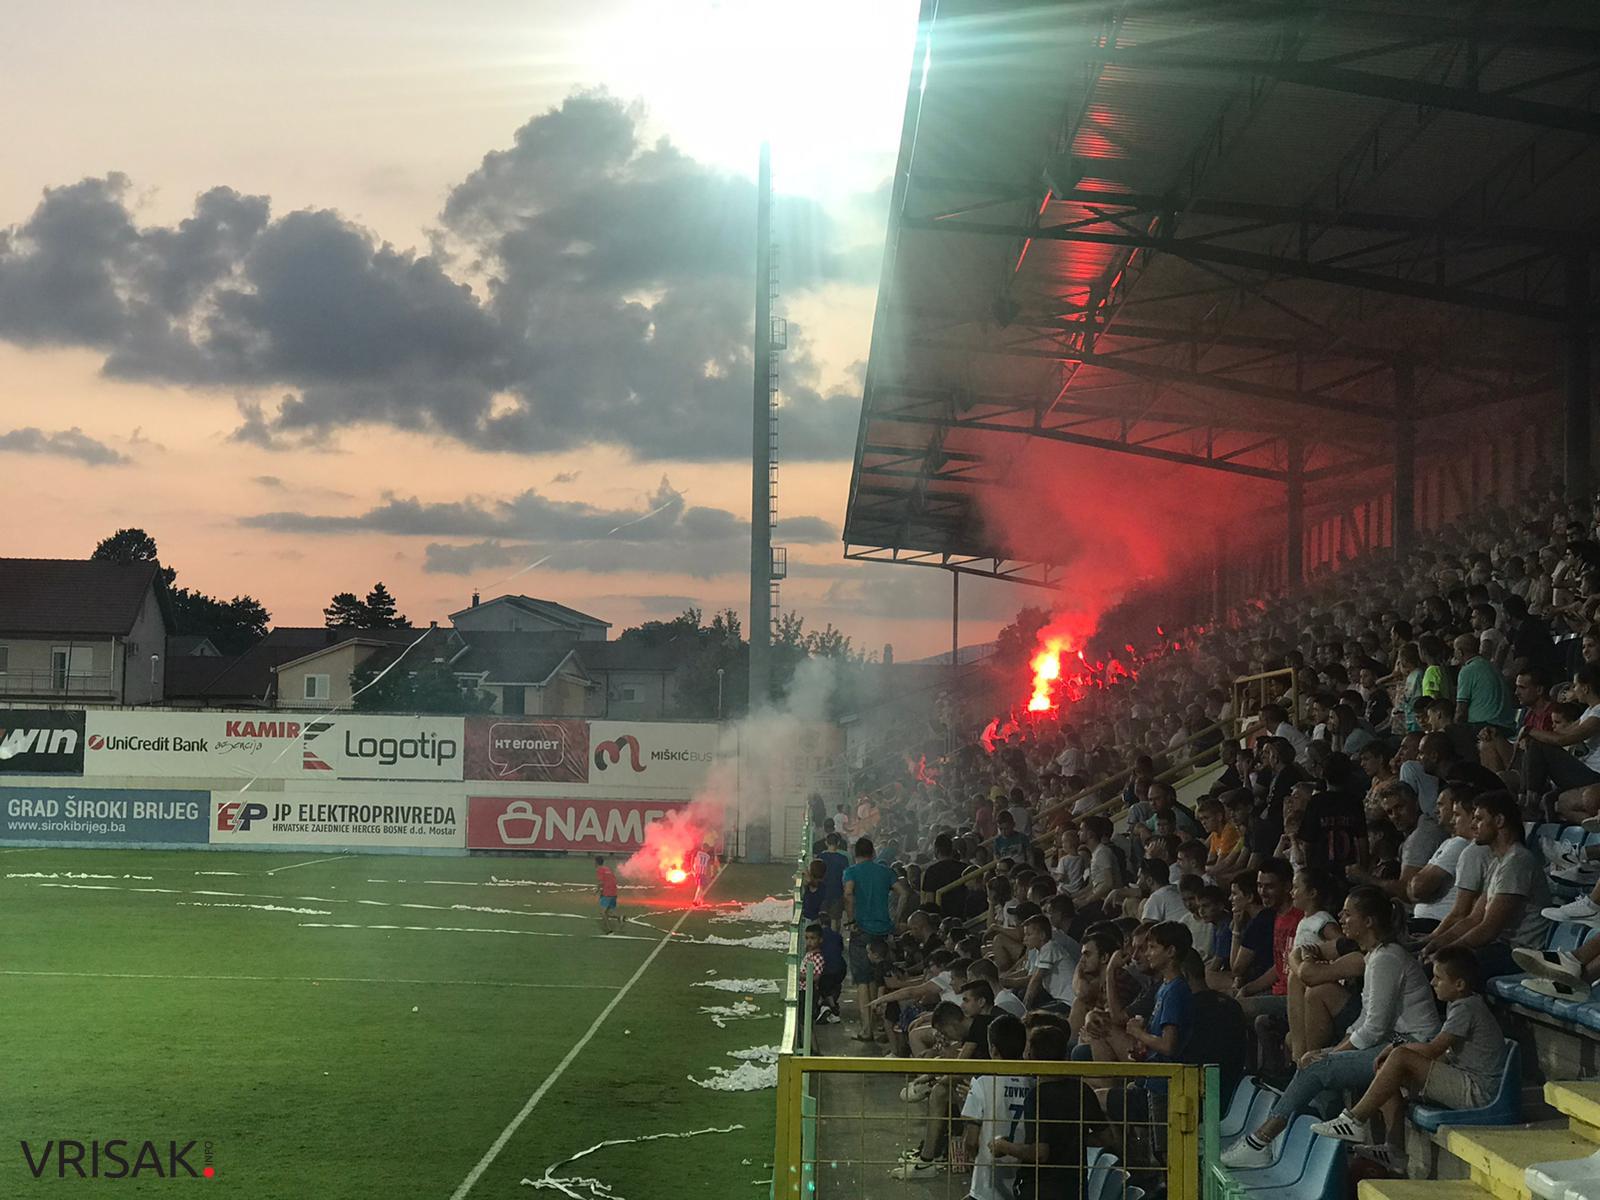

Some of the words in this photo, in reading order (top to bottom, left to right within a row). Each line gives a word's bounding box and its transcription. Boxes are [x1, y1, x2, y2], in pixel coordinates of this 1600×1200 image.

[226, 720, 300, 738] KAMIR
[106, 736, 169, 751] UniCredit
[173, 737, 208, 752] Bank
[345, 730, 456, 766] Logotip
[7, 799, 59, 817] GRAD
[65, 795, 127, 818] ŠIROKI
[133, 801, 199, 820] BRIJEG
[272, 803, 292, 822] JP
[299, 804, 456, 825] ELEKTROPRIVREDA
[8, 819, 126, 834] www.sirokibrijeg.ba
[272, 823, 309, 832] HRVATSKE
[311, 824, 350, 833] ZAJEDNICE
[352, 825, 381, 834] HERCEG
[383, 826, 408, 835] BOSNE
[410, 826, 426, 835] d.d.
[429, 827, 456, 836] Mostar
[1009, 1103, 1025, 1143] 7
